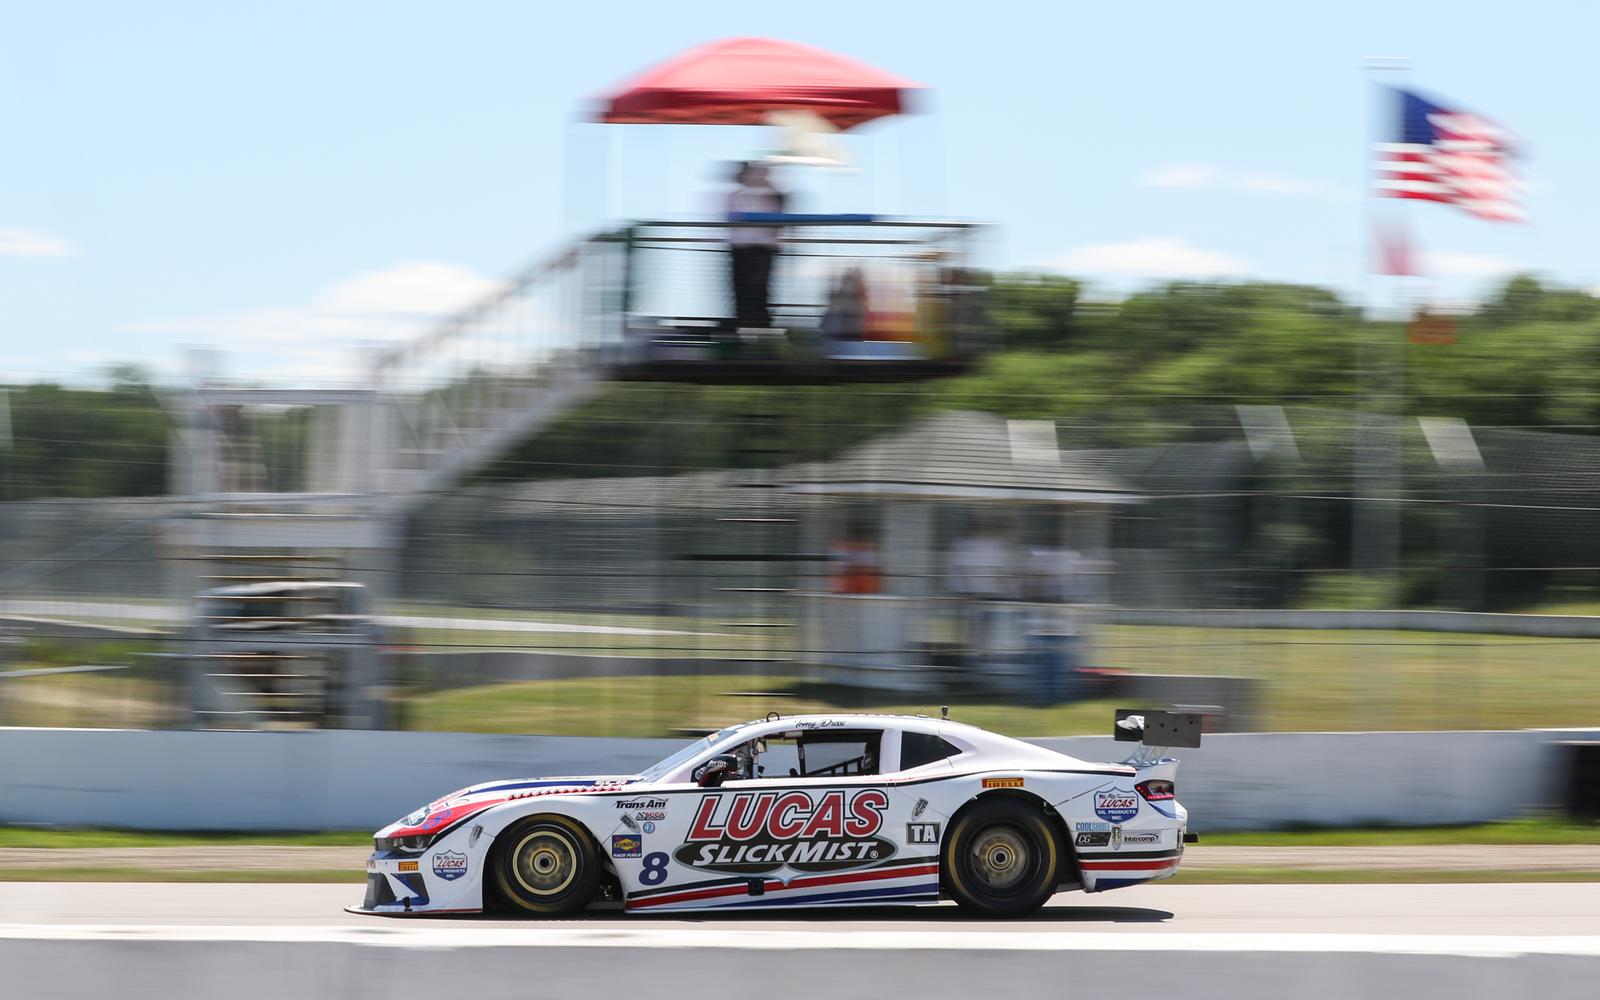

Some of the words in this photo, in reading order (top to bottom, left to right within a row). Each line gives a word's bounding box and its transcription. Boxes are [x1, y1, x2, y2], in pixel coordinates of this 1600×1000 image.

[615, 800, 646, 809] Trans
[646, 799, 667, 808] Am
[1100, 799, 1136, 808] LUCAS
[685, 789, 889, 843] LUCAS
[911, 825, 937, 842] TA
[437, 860, 465, 868] LUCAS
[639, 852, 670, 886] 8
